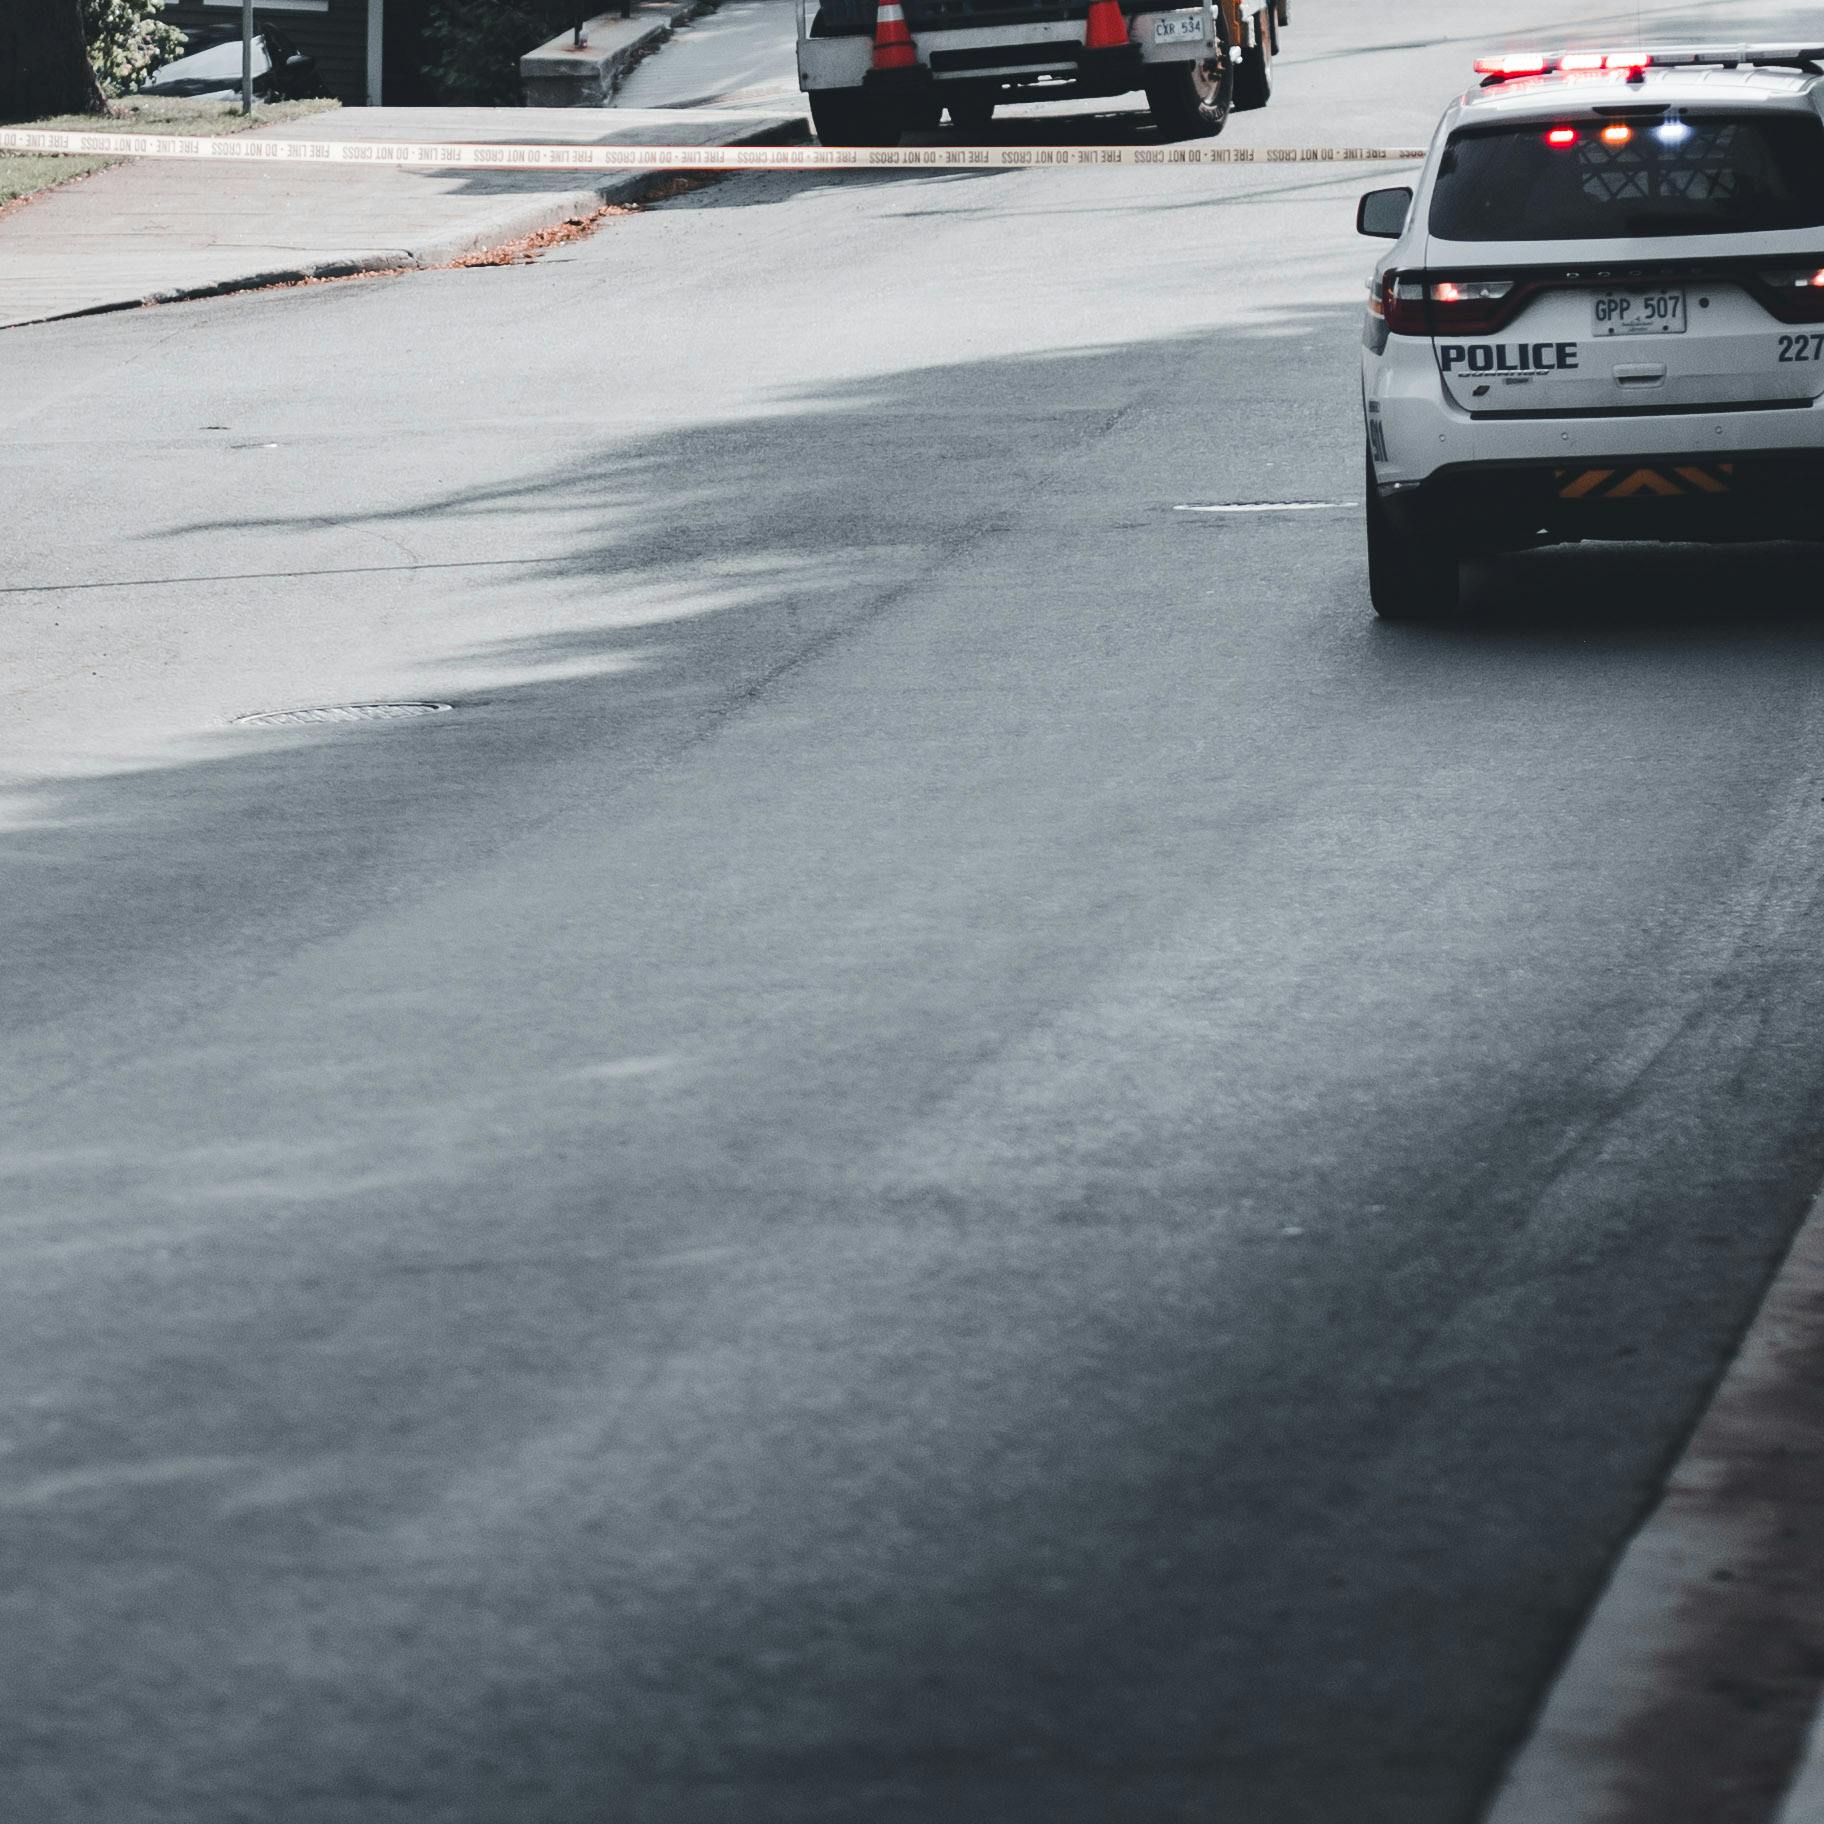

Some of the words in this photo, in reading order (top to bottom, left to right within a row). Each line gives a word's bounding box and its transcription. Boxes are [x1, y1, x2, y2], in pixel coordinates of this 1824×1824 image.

[1181, 20, 1201, 34] 534
[5, 133, 17, 147] DO
[26, 134, 46, 147] LINE
[48, 134, 69, 149] FIRE
[81, 136, 111, 150] CROSS
[114, 137, 132, 151] NOT
[135, 138, 147, 153] DO
[156, 139, 176, 154] LINE
[179, 140, 199, 154] FIRE
[212, 142, 242, 156] CROSS
[245, 142, 262, 156] NOT
[265, 143, 277, 157] DO
[287, 144, 306, 157] LINE
[309, 144, 330, 158] FIRE
[343, 146, 373, 159] CROSS
[376, 147, 393, 160] NOT
[396, 147, 409, 160] DO
[1343, 147, 1363, 160] LINE
[418, 147, 438, 161] LINE
[441, 148, 461, 161] FIRE
[474, 149, 504, 162] CROSS
[507, 149, 525, 163] NOT
[527, 150, 540, 163] DO
[550, 150, 569, 163] LINE
[572, 150, 593, 163] FIRE
[605, 151, 636, 164] CROSS
[639, 151, 656, 164] NOT
[659, 151, 672, 164] DO
[681, 152, 701, 164] LINE
[704, 152, 725, 164] FIRE
[737, 151, 768, 164] CROSS
[771, 151, 788, 164] NOT
[791, 151, 804, 163] DO
[813, 151, 833, 163] LINE
[836, 151, 856, 163] FIRE
[869, 151, 900, 164] CROSS
[903, 151, 921, 164] NOT
[923, 151, 936, 164] DO
[945, 151, 965, 163] LINE
[968, 150, 989, 163] FIRE
[1001, 150, 1032, 164] CROSS
[1035, 150, 1053, 164] NOT
[1055, 150, 1068, 163] DO
[1078, 150, 1098, 163] LINE
[1100, 150, 1122, 163] FIRE
[1134, 149, 1165, 163] CROSS
[1168, 149, 1186, 163] NOT
[1188, 149, 1201, 162] DO
[1210, 148, 1231, 162] LINE
[1233, 148, 1254, 162] FIRE
[1267, 149, 1297, 162] CROSS
[1300, 148, 1318, 161] NOT
[1321, 148, 1334, 160] DO
[1596, 298, 1631, 321] GPP
[1643, 295, 1680, 319] 507
[1778, 333, 1824, 362] 227
[1440, 342, 1579, 372] POLICE
